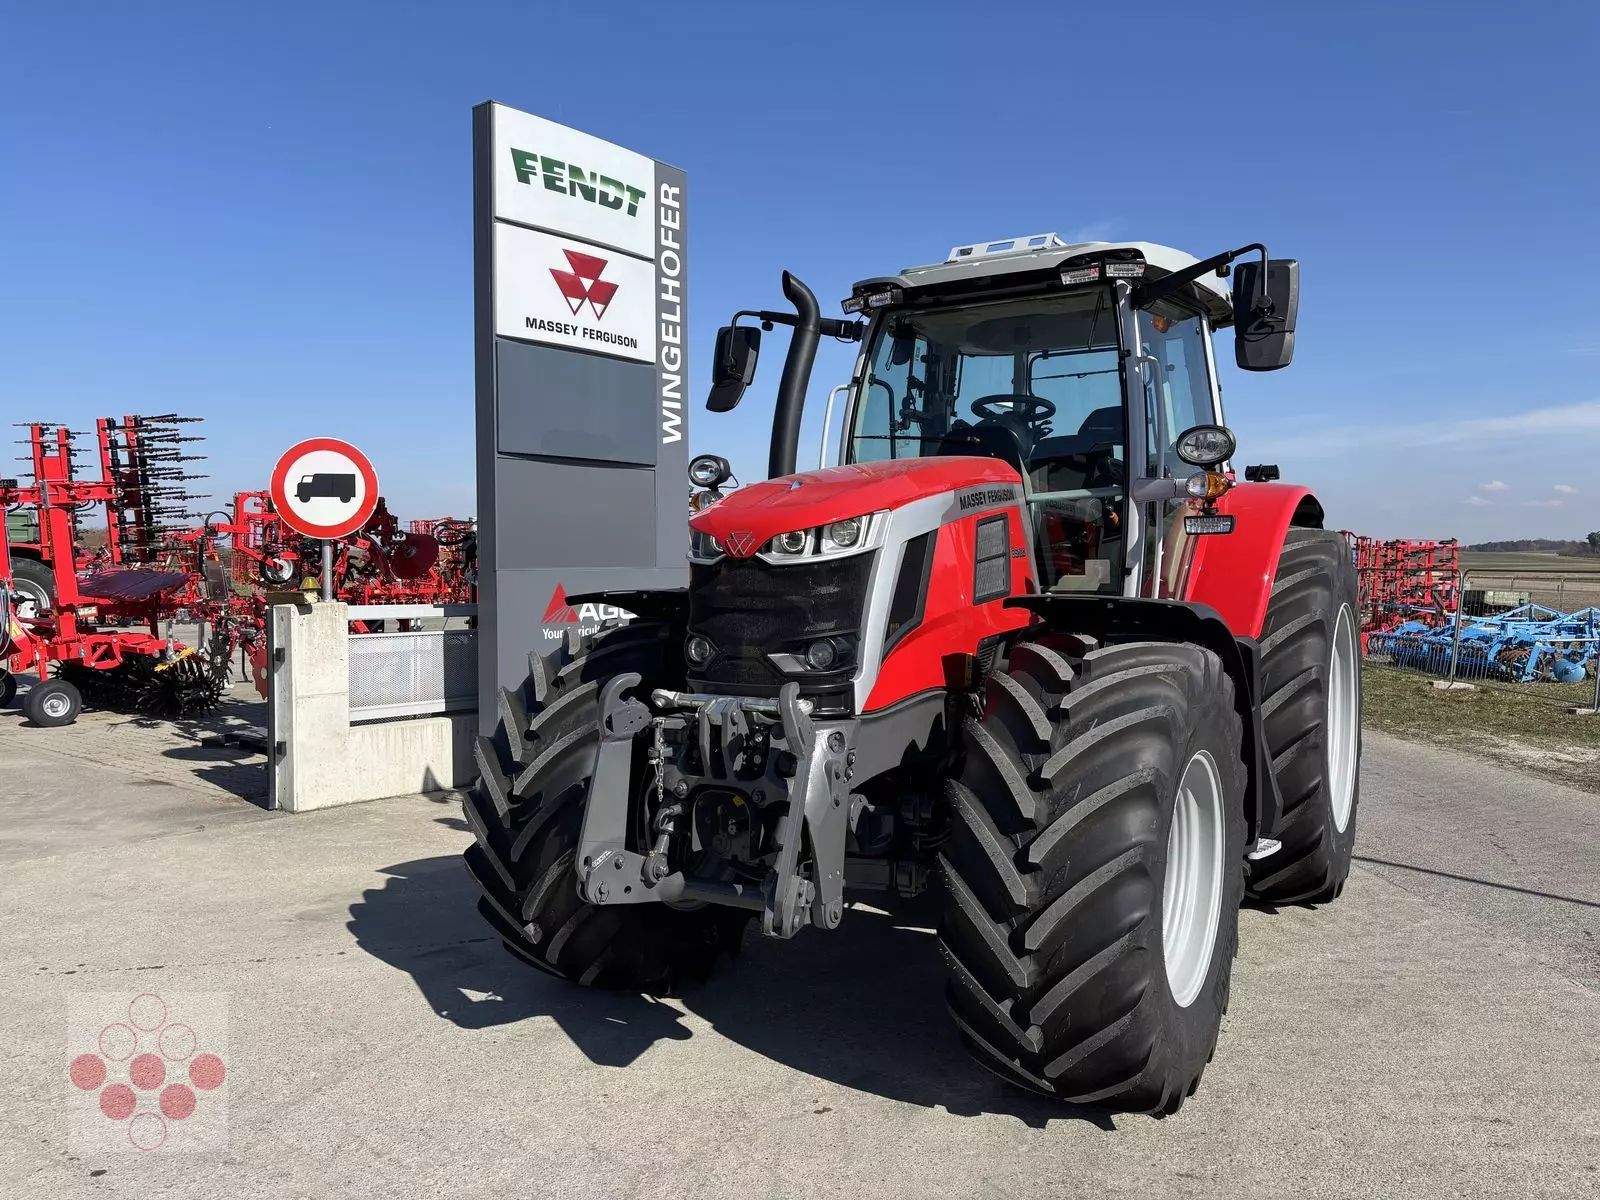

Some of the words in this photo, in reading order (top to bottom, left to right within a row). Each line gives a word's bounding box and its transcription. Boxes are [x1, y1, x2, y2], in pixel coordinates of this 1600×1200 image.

[510, 147, 646, 217] FENDT
[660, 182, 682, 445] WINGELHOFER
[525, 316, 578, 336] MASSEY
[582, 327, 638, 349] FERGUSON
[960, 491, 987, 510] MASSEY
[987, 489, 1015, 503] FERGUSON
[542, 628, 563, 639] Your
